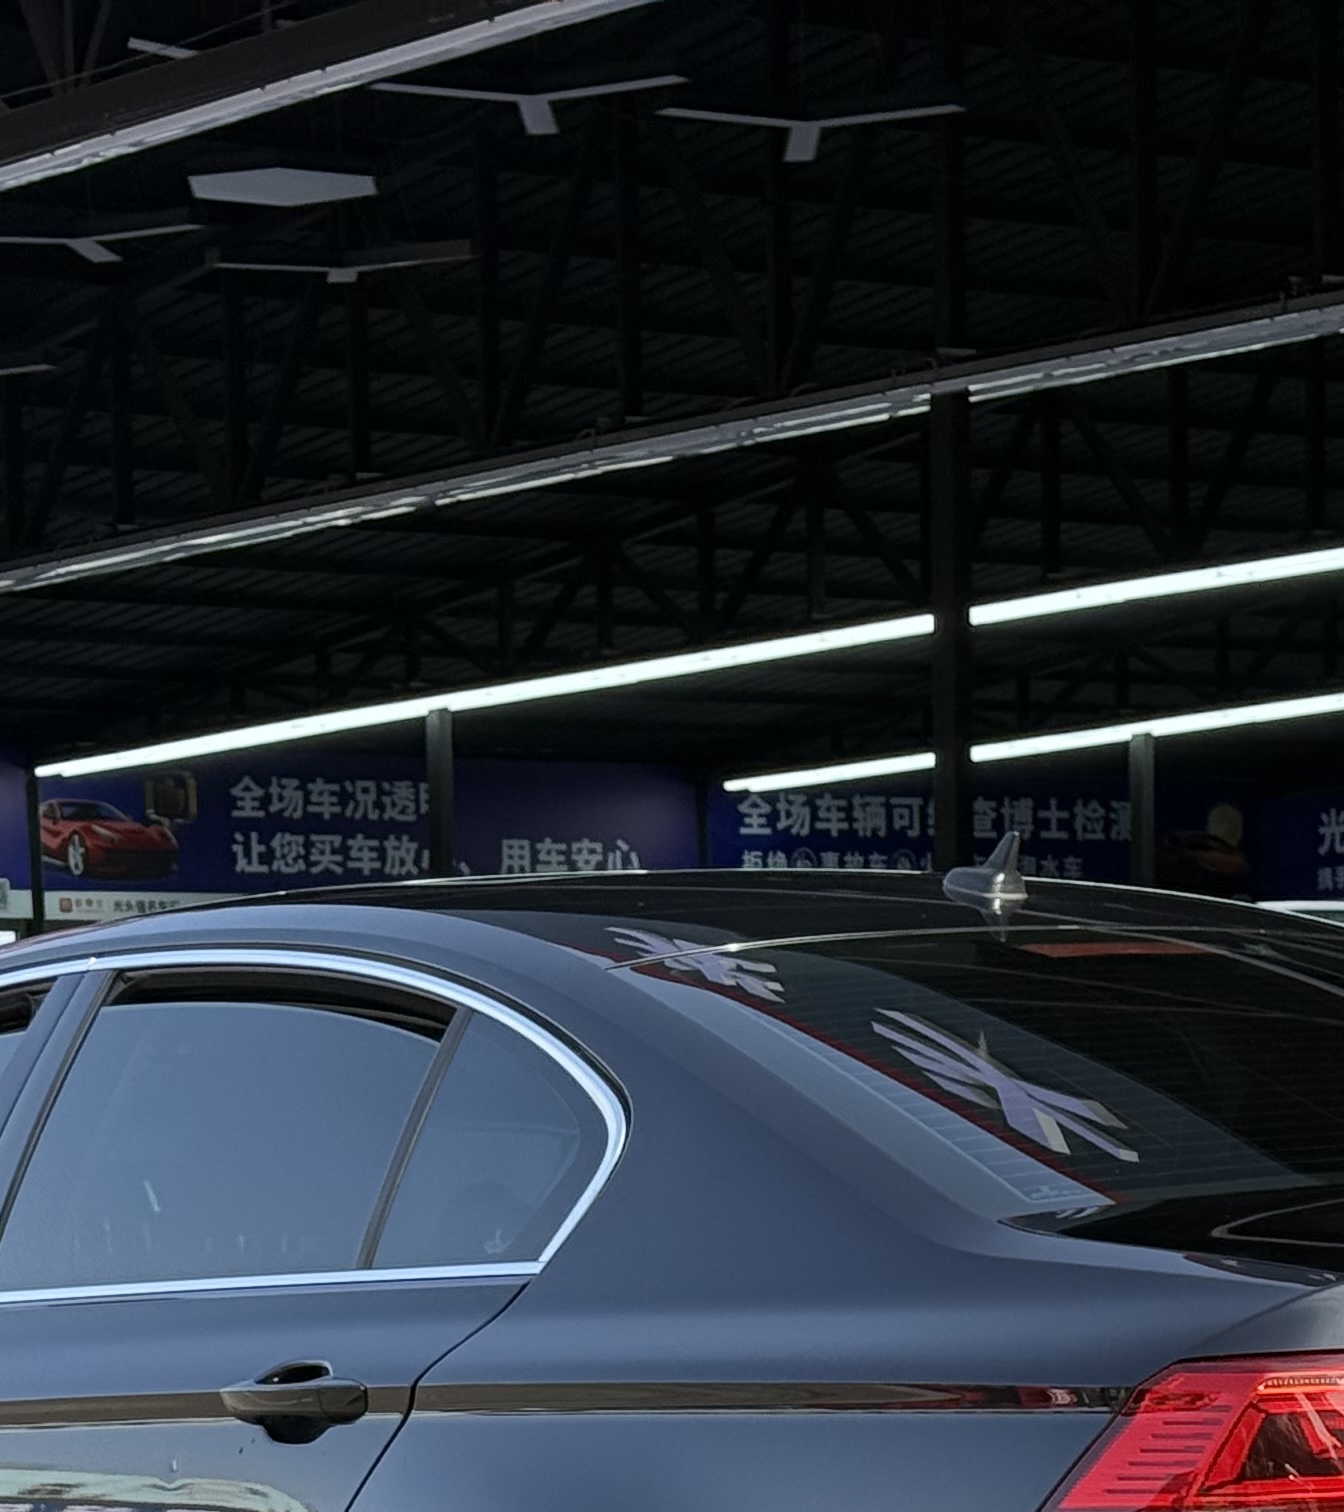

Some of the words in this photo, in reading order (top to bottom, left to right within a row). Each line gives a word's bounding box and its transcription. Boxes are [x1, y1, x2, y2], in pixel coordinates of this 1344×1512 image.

[736, 793, 1131, 841] 全场车辆可查博士检测
